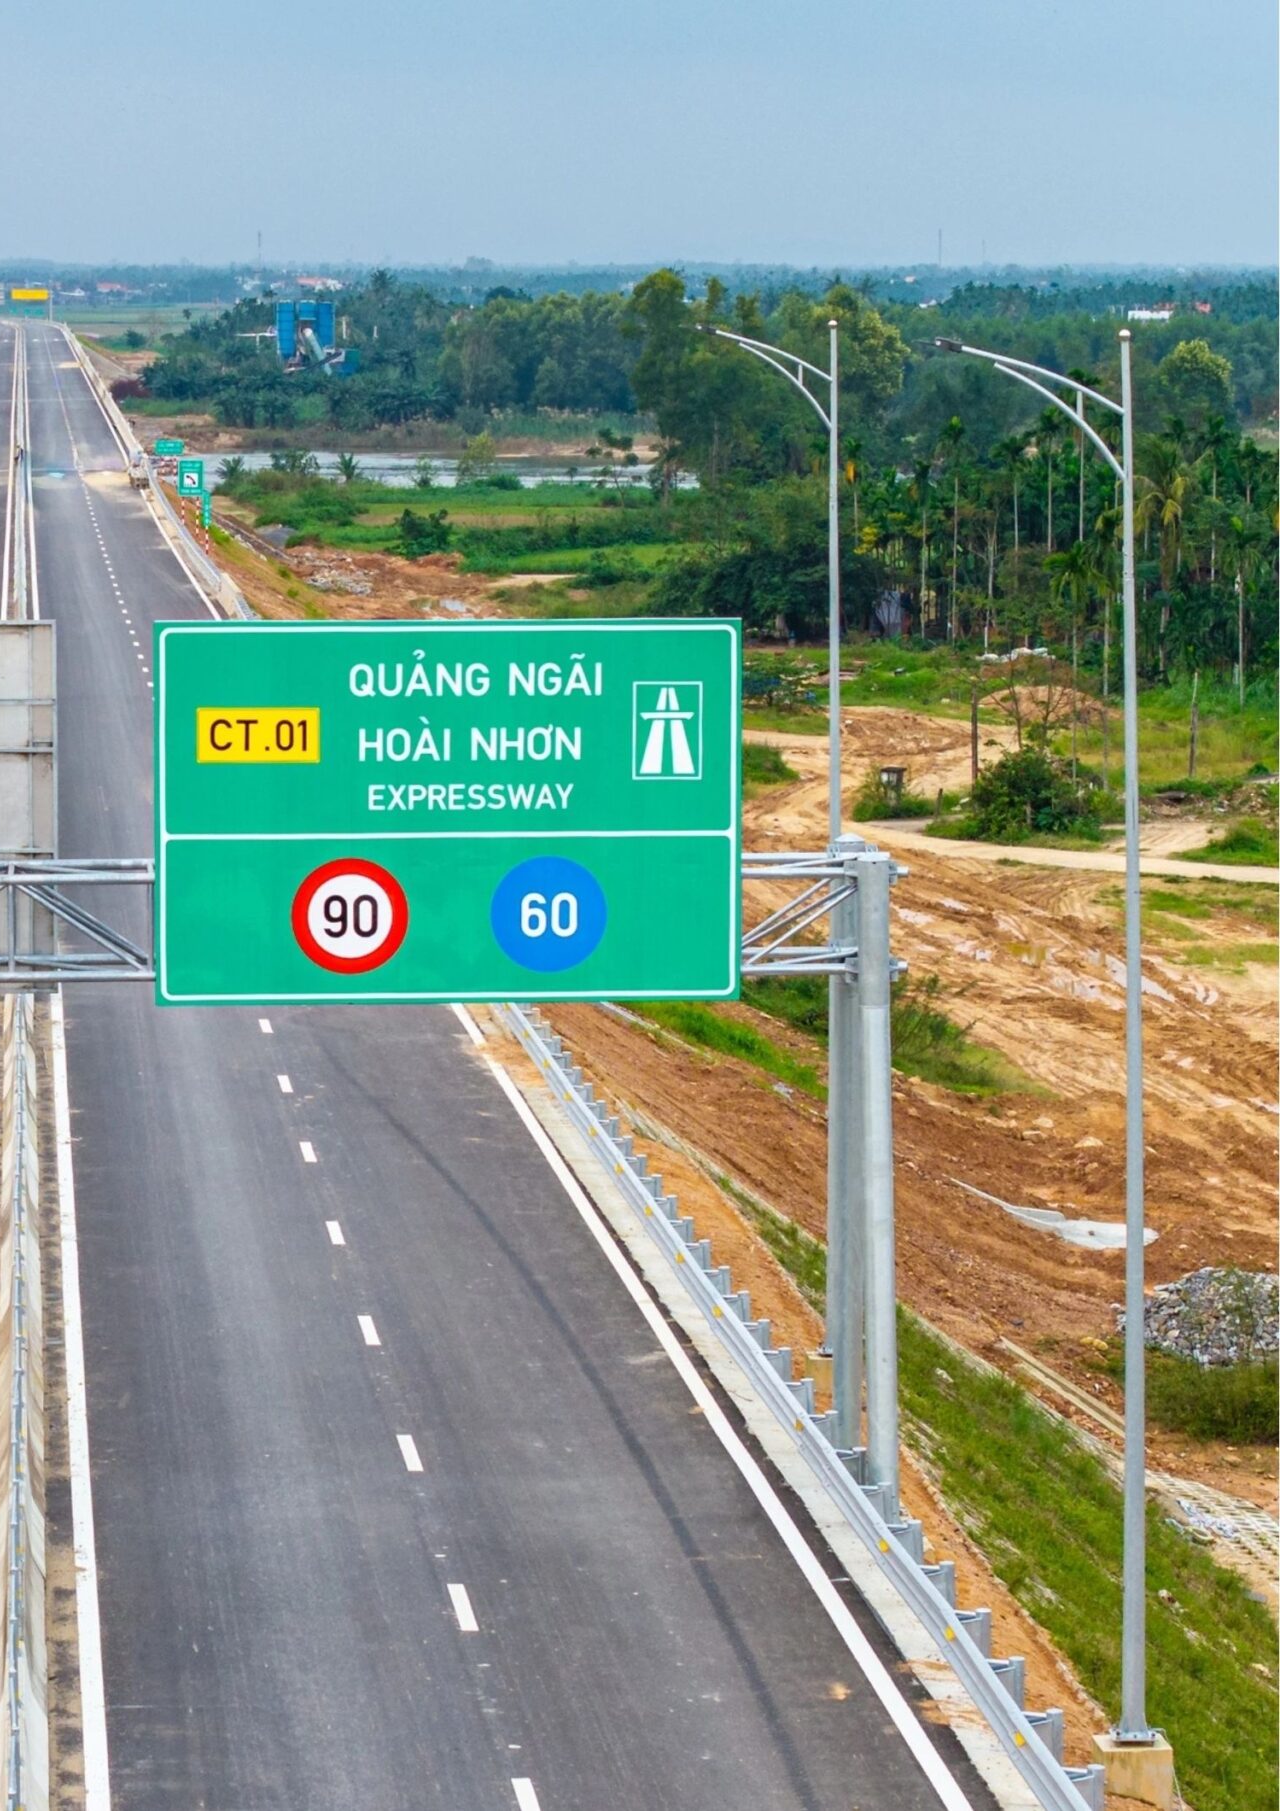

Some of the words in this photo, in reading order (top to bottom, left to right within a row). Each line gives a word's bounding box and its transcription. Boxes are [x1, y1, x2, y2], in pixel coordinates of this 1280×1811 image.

[348, 649, 490, 698] QUẢNG
[508, 653, 603, 697] NGÃI
[209, 719, 307, 752] CT.01
[358, 717, 451, 762] HOÀI
[470, 724, 582, 761] NHƠN
[367, 783, 574, 811] EXPRESSWAY
[323, 894, 380, 939] 90
[519, 892, 579, 938] 60
